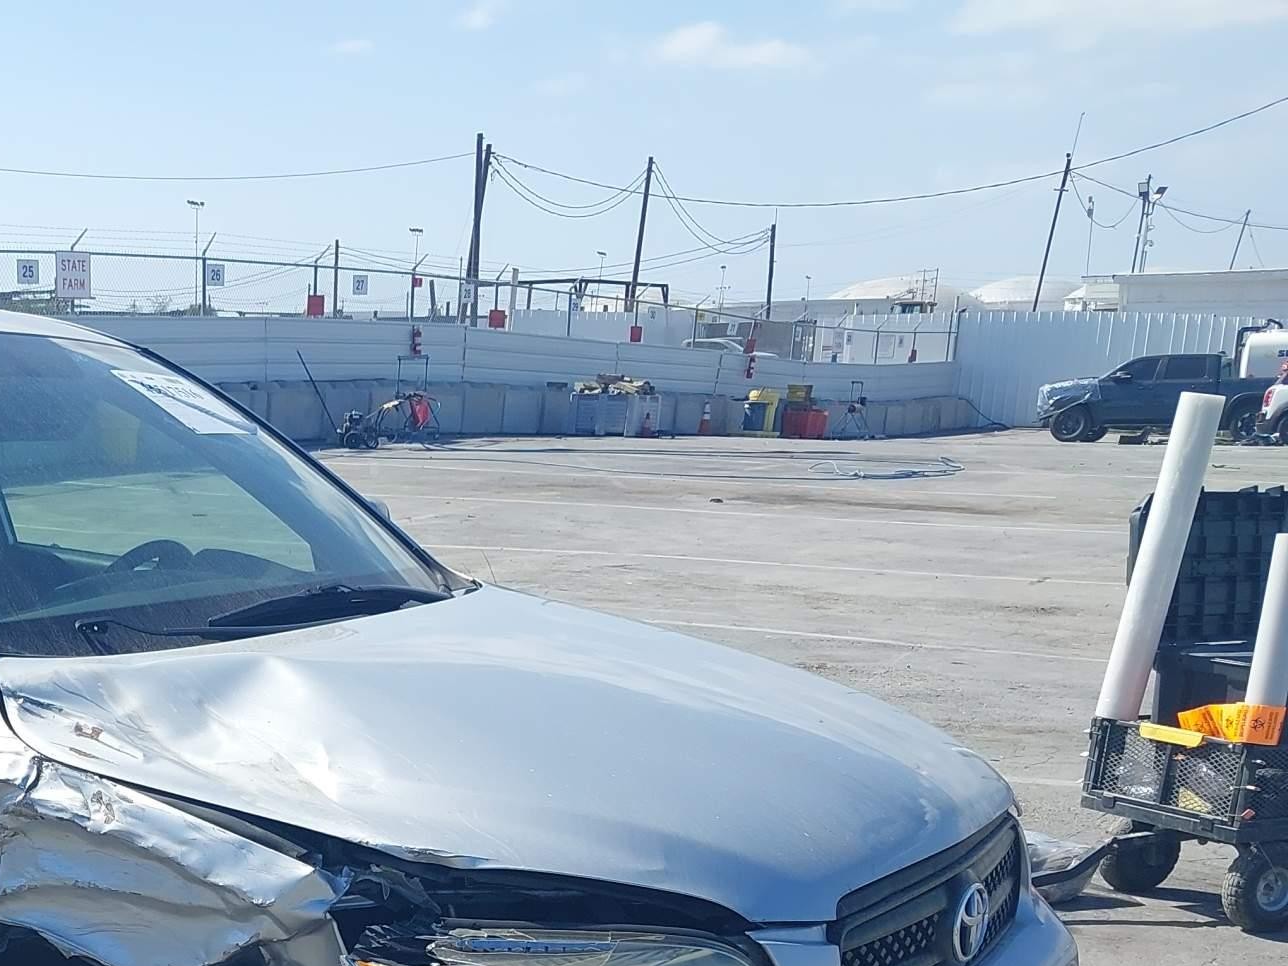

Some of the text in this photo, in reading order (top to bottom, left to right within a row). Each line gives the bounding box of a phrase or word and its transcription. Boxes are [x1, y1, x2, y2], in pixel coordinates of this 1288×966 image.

[22, 265, 34, 278] 25
[61, 259, 86, 272] STATE
[211, 269, 221, 281] 26
[62, 278, 86, 290] FARM
[355, 279, 365, 291] 27
